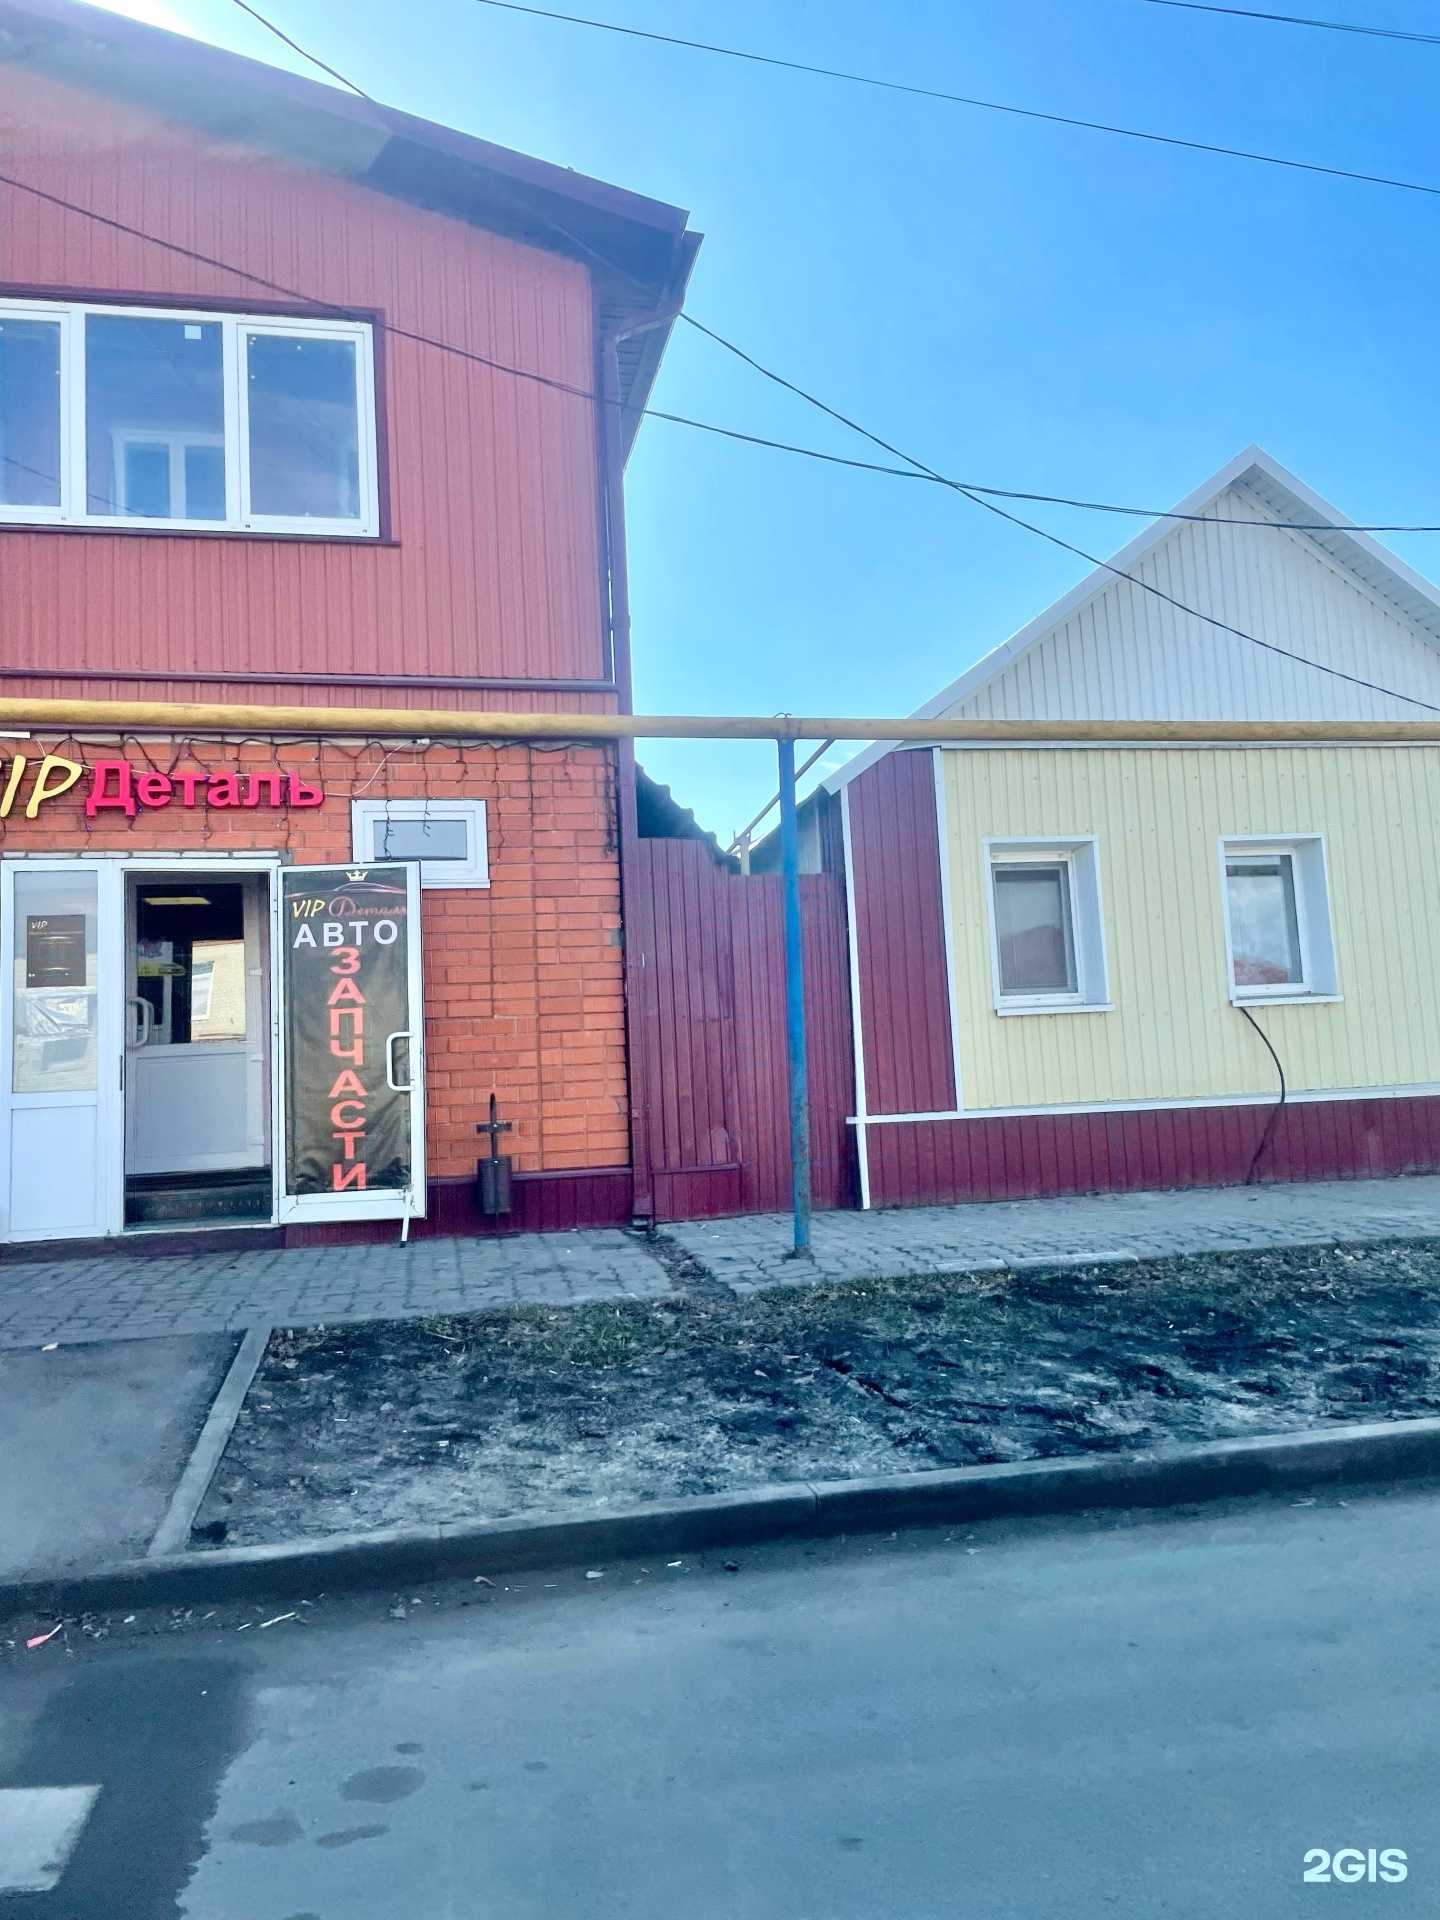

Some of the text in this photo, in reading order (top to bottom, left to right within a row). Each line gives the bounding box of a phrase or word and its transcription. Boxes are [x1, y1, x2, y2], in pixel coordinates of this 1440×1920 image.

[0, 754, 324, 819] IP Деталь
[292, 899, 326, 918] VIP
[292, 919, 398, 949] АВТО
[327, 946, 369, 1192] ЗАПЧАСТИ
